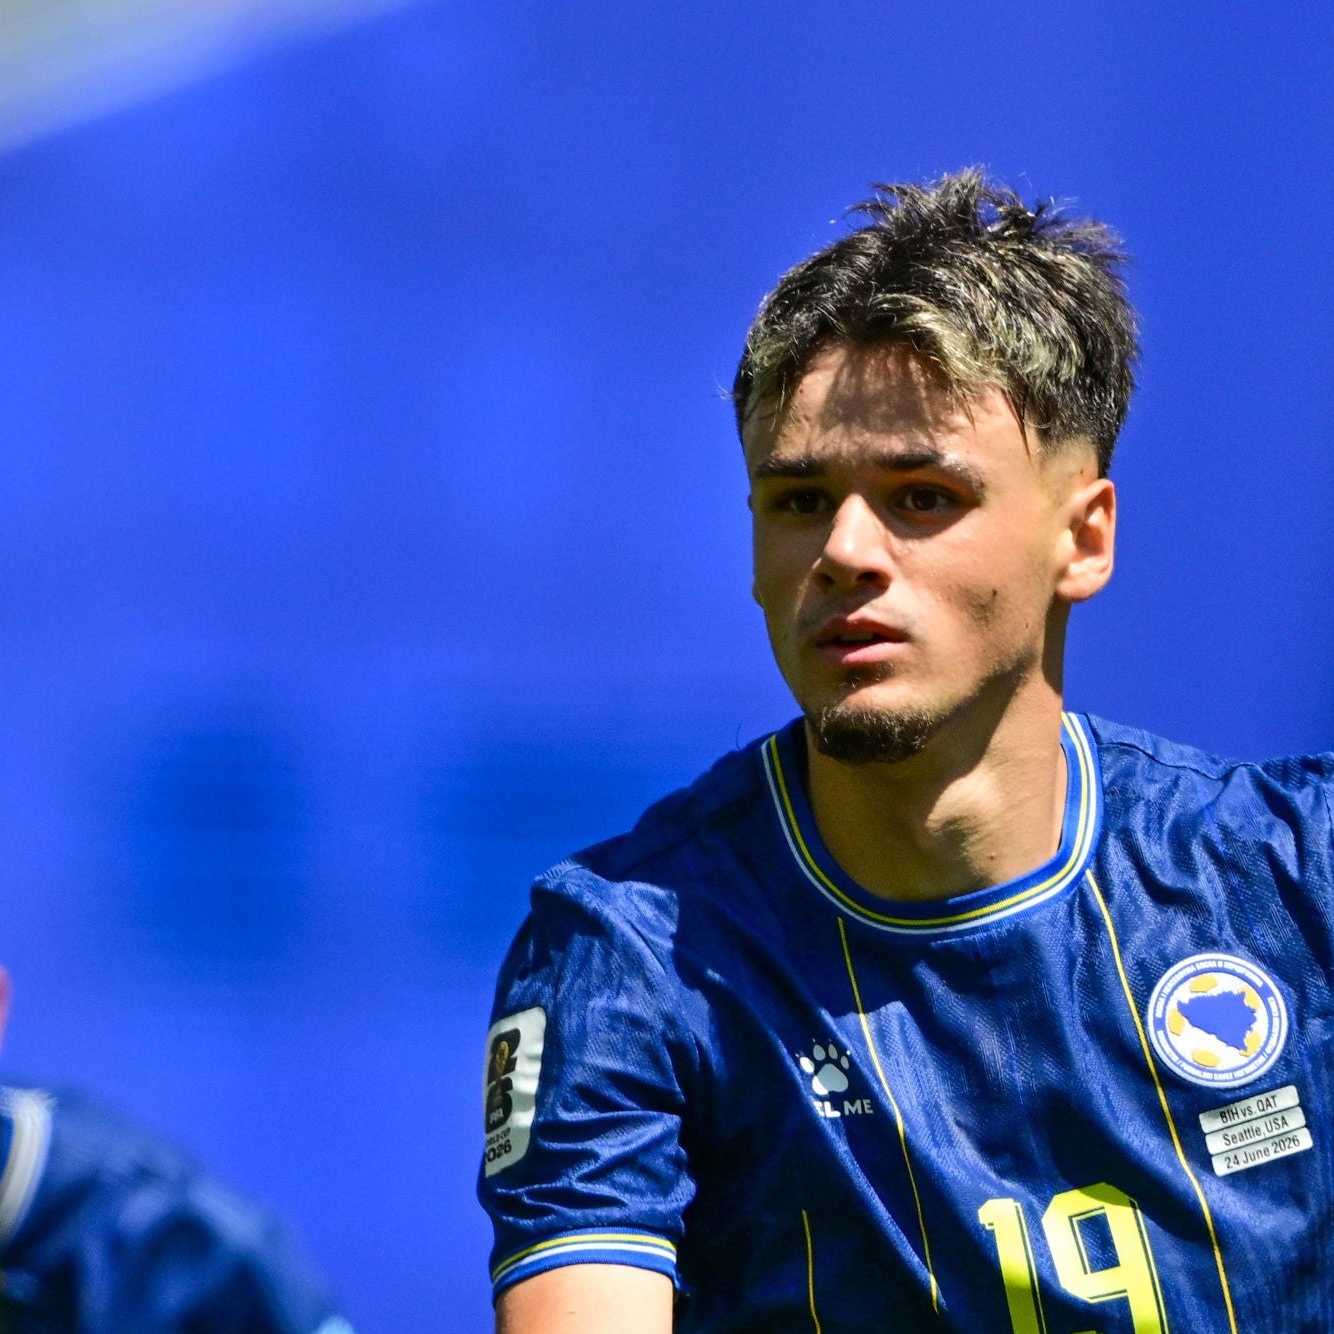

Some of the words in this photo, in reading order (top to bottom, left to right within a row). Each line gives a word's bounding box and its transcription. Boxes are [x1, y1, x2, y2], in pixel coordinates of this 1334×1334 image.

[1220, 1107, 1240, 1124] BIH
[1240, 1106, 1256, 1117] vs.
[1256, 1095, 1278, 1112] QAT
[1222, 1125, 1266, 1146] Seattle,
[1265, 1116, 1289, 1133] USA
[485, 1139, 512, 1162] 026
[1224, 1154, 1240, 1170] 24
[1243, 1147, 1270, 1164] June
[1271, 1135, 1300, 1154] 2026
